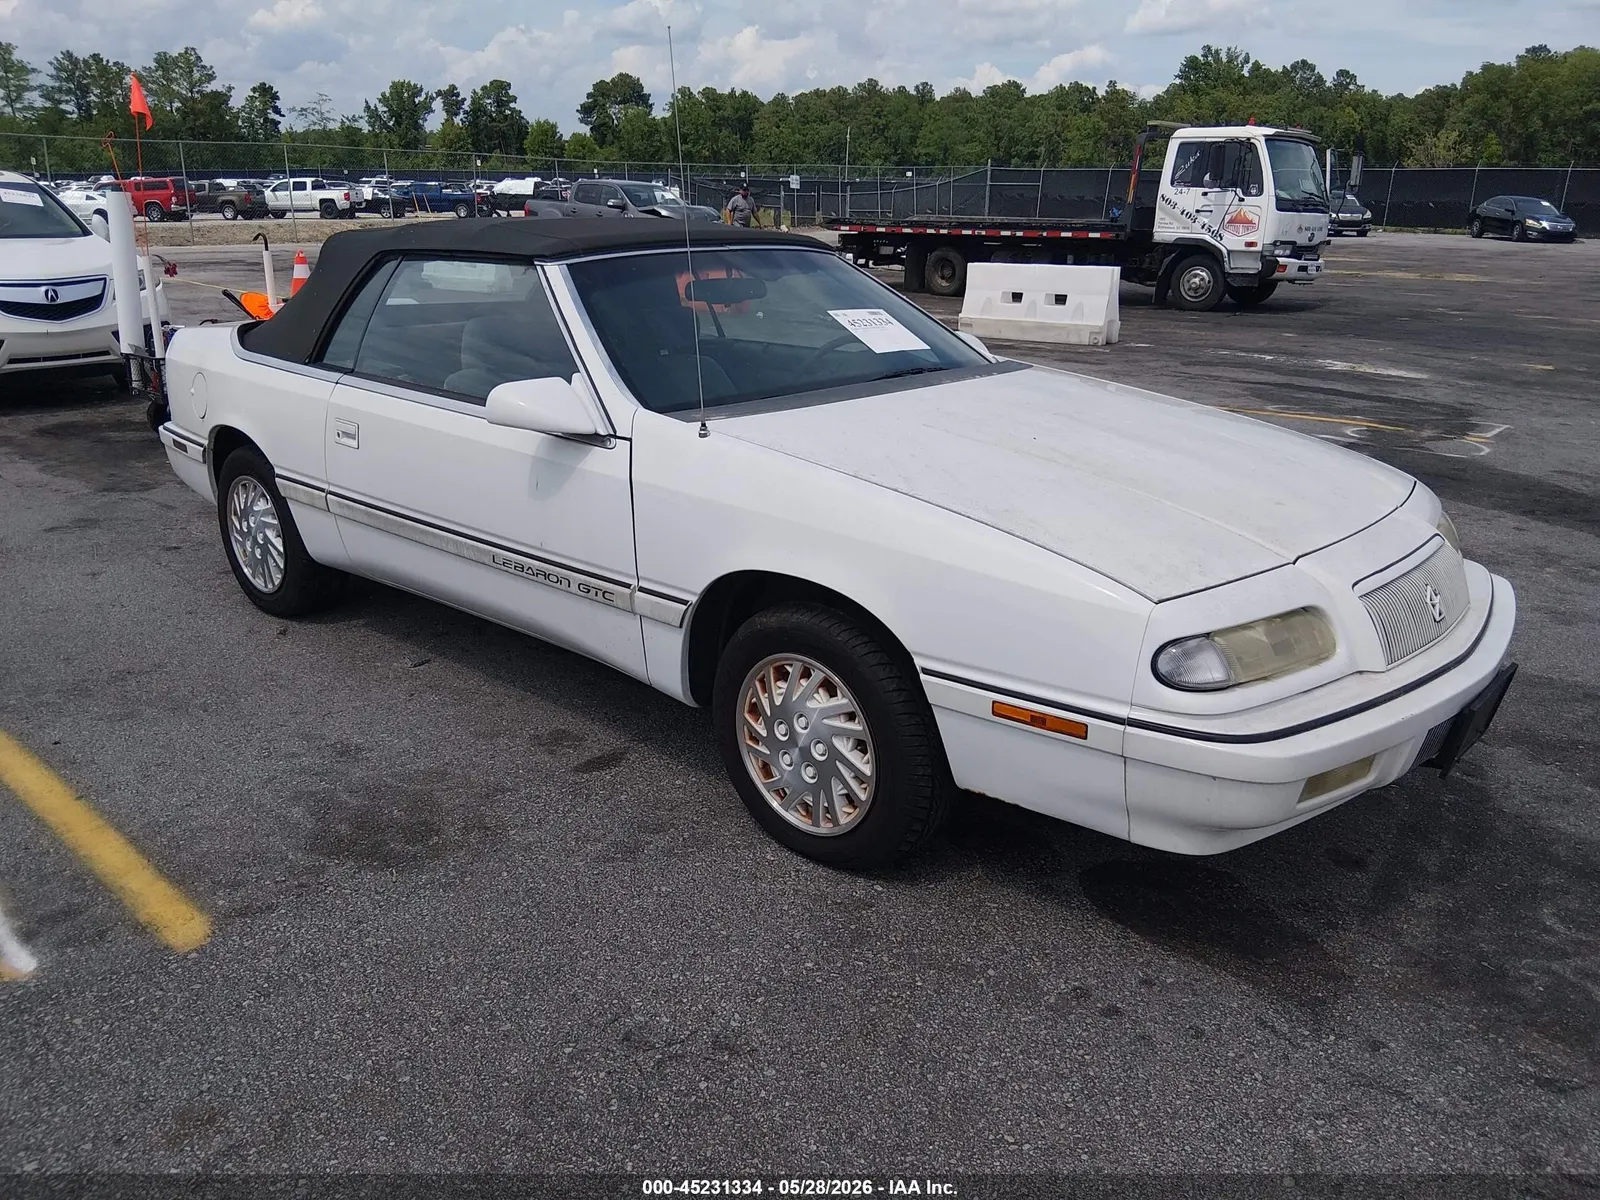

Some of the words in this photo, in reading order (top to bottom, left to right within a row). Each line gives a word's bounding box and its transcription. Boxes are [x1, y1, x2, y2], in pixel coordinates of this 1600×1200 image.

[1160, 193, 1225, 241] 803-403-4508
[848, 318, 894, 327] 45231334
[492, 554, 571, 588] LEBARON
[577, 582, 615, 602] GTC
